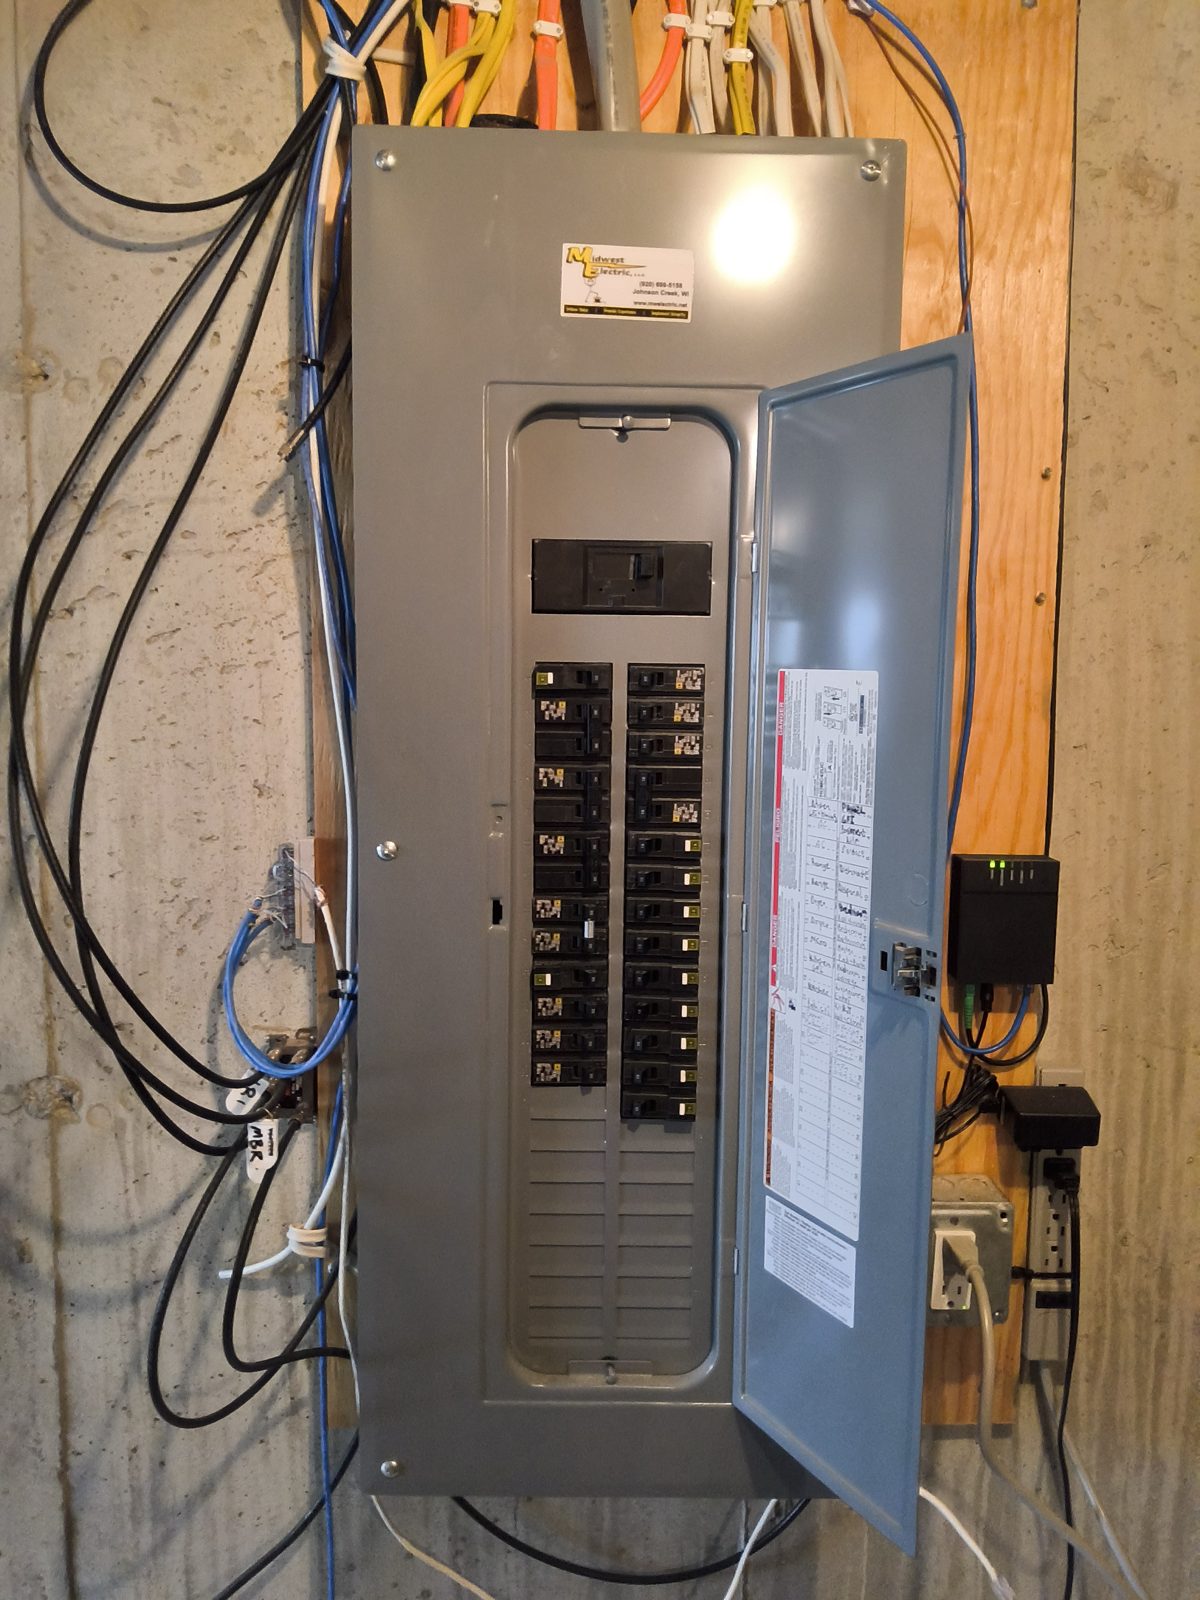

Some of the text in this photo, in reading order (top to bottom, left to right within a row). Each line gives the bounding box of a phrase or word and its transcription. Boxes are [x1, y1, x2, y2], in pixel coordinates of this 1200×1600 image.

[566, 246, 625, 264] Midwest
[632, 288, 660, 296] Johnson
[249, 1125, 264, 1163] MBR
